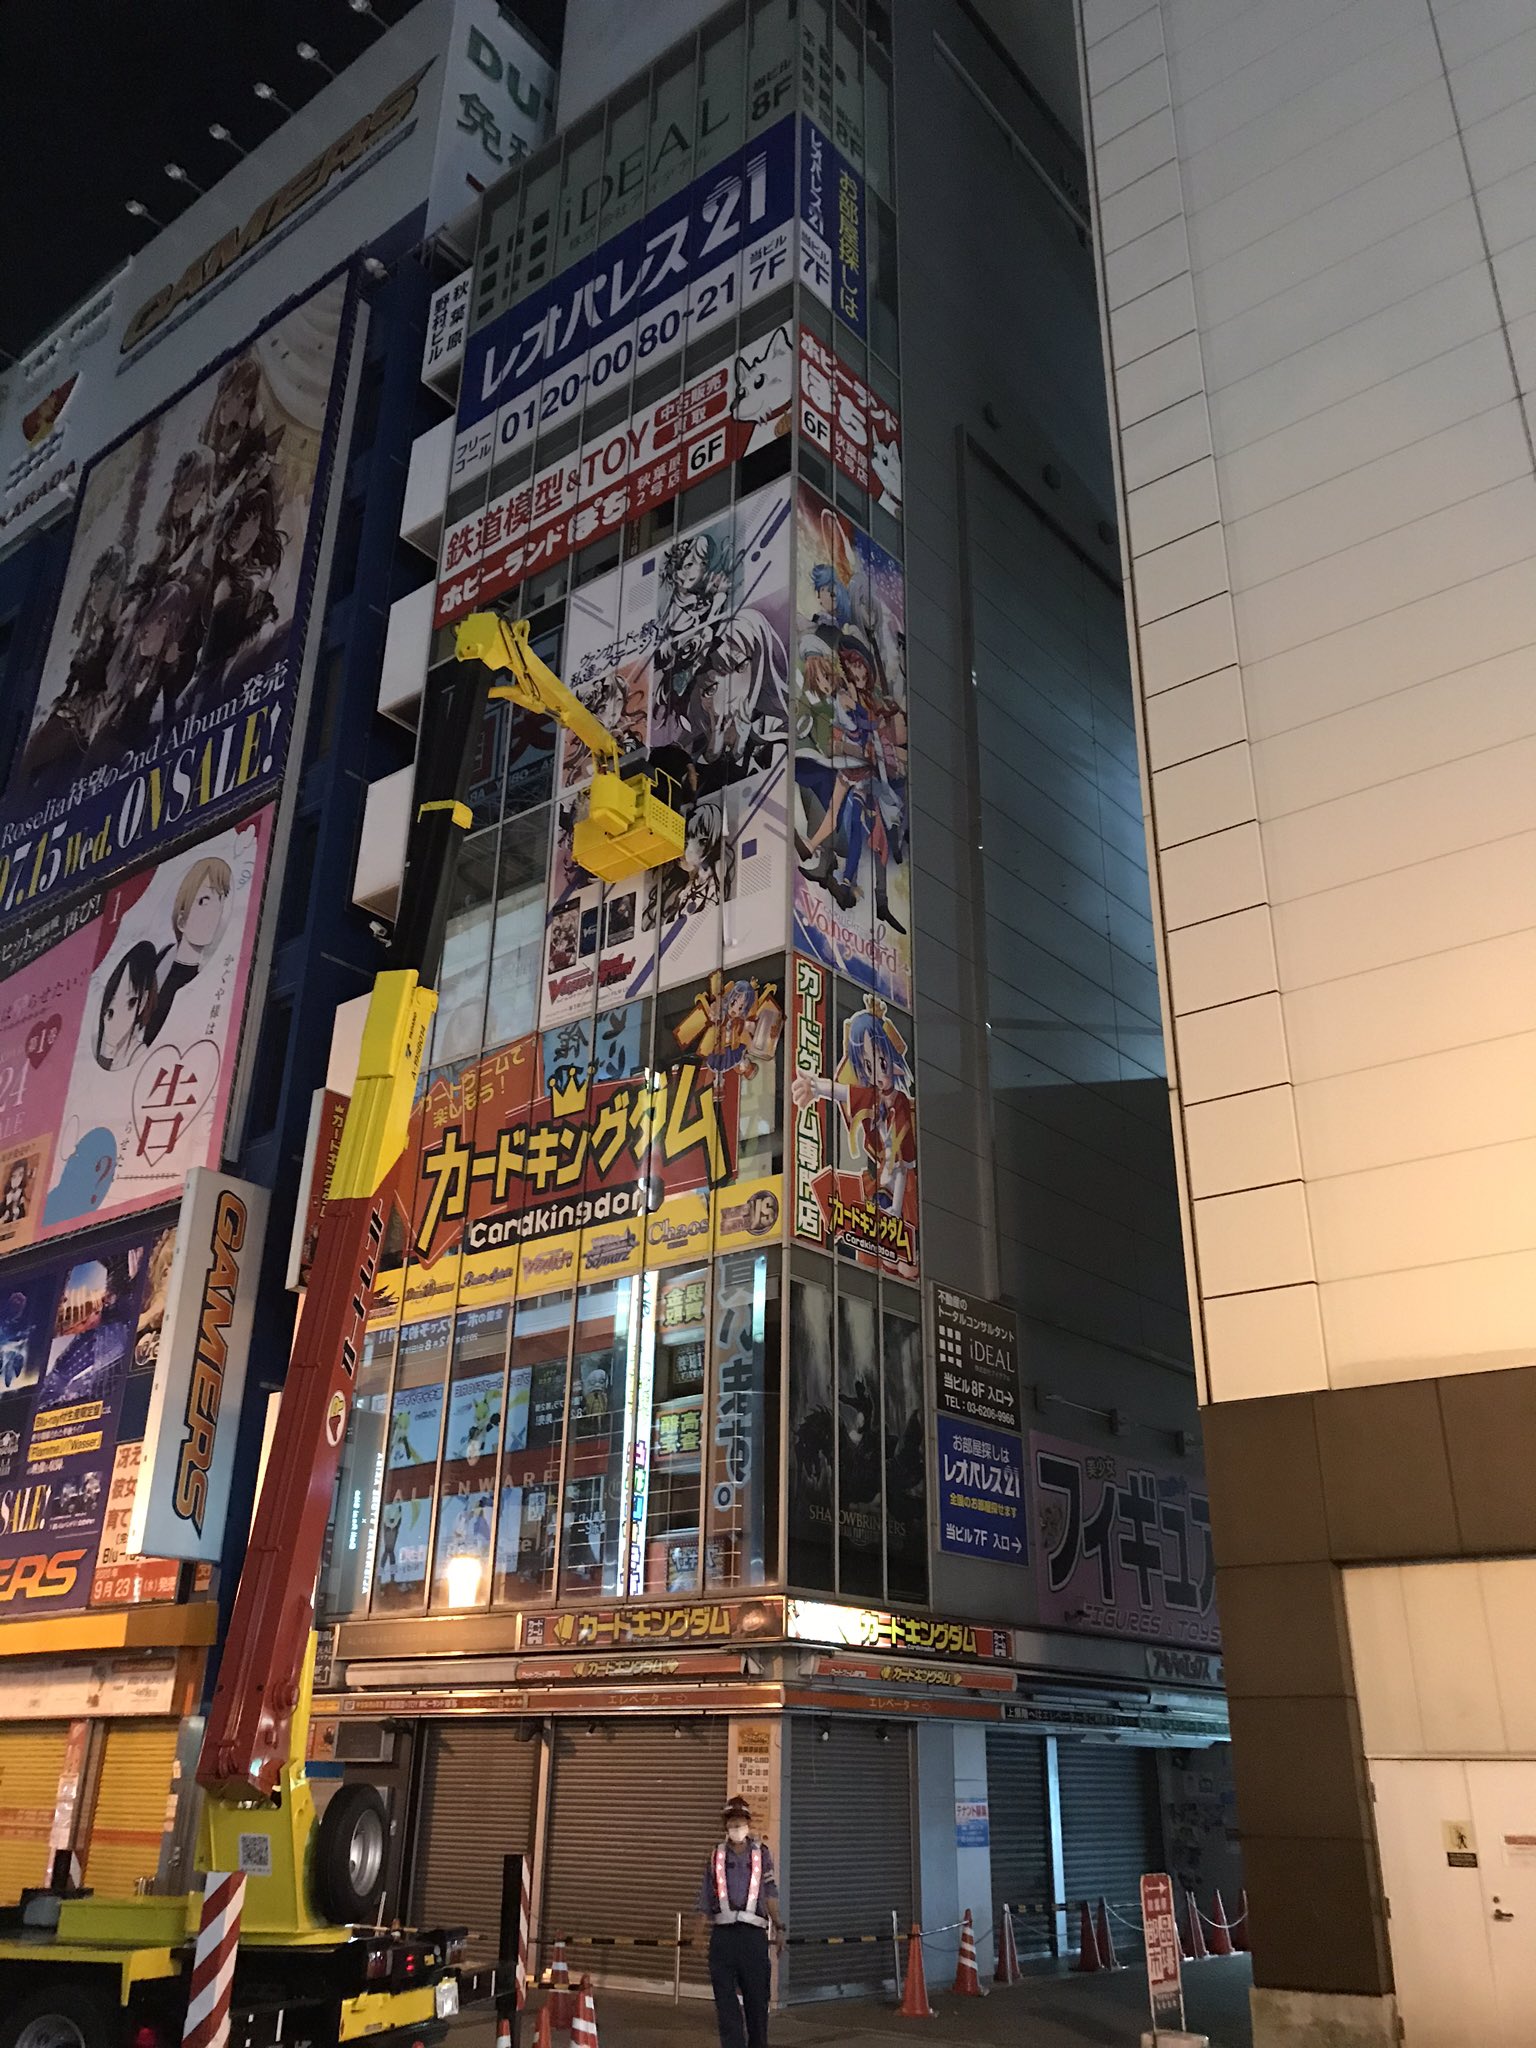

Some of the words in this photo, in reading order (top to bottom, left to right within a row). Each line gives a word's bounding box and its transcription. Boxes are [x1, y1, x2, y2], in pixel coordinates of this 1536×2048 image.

[753, 57, 791, 93] 当ビル
[751, 74, 791, 121] 8F
[750, 234, 786, 264] 当ビル
[801, 228, 831, 264] 当ビル
[481, 150, 767, 401] レオパレス21
[748, 248, 787, 291] 7F
[802, 246, 831, 286] 7F
[428, 292, 450, 365] 野村ビル
[446, 280, 468, 353] 秋葉原
[660, 374, 724, 421] 中古販売
[672, 405, 707, 442] 買取
[803, 409, 829, 442] 6F
[454, 443, 492, 475] コール
[457, 432, 492, 460] フリー
[690, 434, 723, 471] 6F
[636, 452, 681, 492] 秋葉原
[136, 1063, 198, 1157] 告
[797, 960, 823, 1240] カードゲム専門店
[418, 1056, 736, 1258] カードキングダム
[829, 1192, 912, 1263] カードキングダム
[937, 1305, 1015, 1343] トータルコンサルタント
[172, 1189, 248, 1542] GAMERS
[968, 1337, 1016, 1374] iDEAL
[987, 1384, 1004, 1404] 入口
[115, 1446, 142, 1469] 冴え
[952, 1434, 1010, 1463] お部屋探しは
[111, 1476, 138, 1500] 彼女
[944, 1453, 1020, 1499] レオパレス21
[106, 1508, 132, 1530] 育て
[993, 1533, 1010, 1551] 入口
[578, 1606, 731, 1643] カードキングダム
[860, 1611, 977, 1653] カードキングダム
[608, 1693, 671, 1705] エレベーター
[869, 1697, 919, 1711] エレベーター
